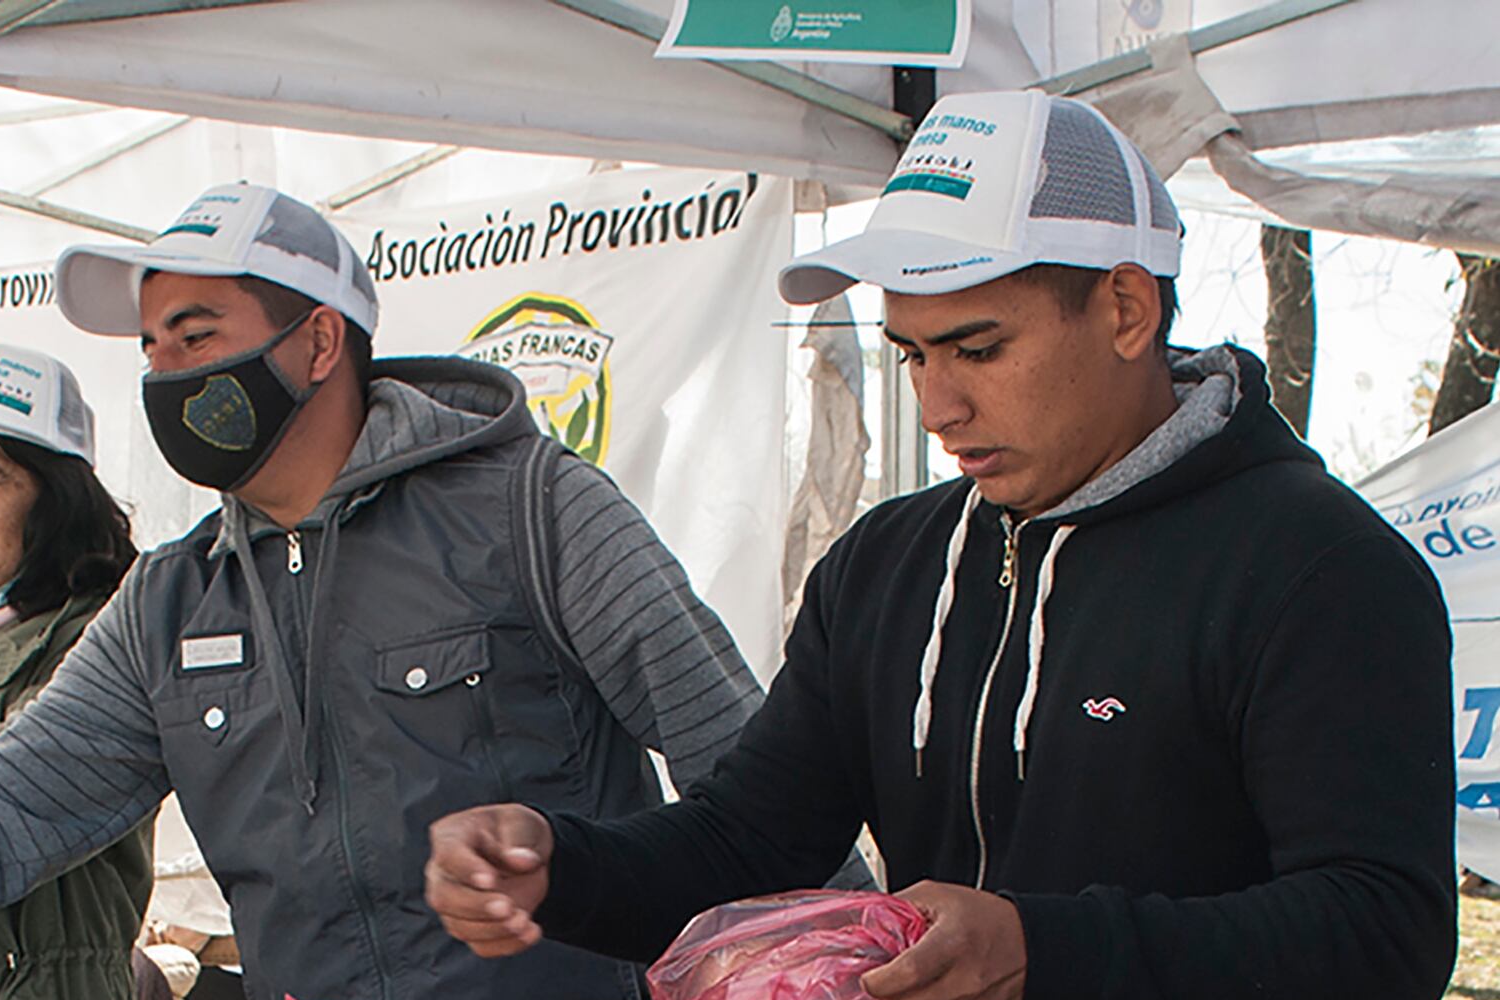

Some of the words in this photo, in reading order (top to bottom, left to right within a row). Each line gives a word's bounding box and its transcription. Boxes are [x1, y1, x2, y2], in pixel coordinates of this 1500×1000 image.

[940, 114, 997, 136] manos
[366, 209, 535, 283] Asociación
[541, 172, 759, 260] Provincial
[518, 332, 601, 363] FRANCAS
[1423, 517, 1497, 559] de
